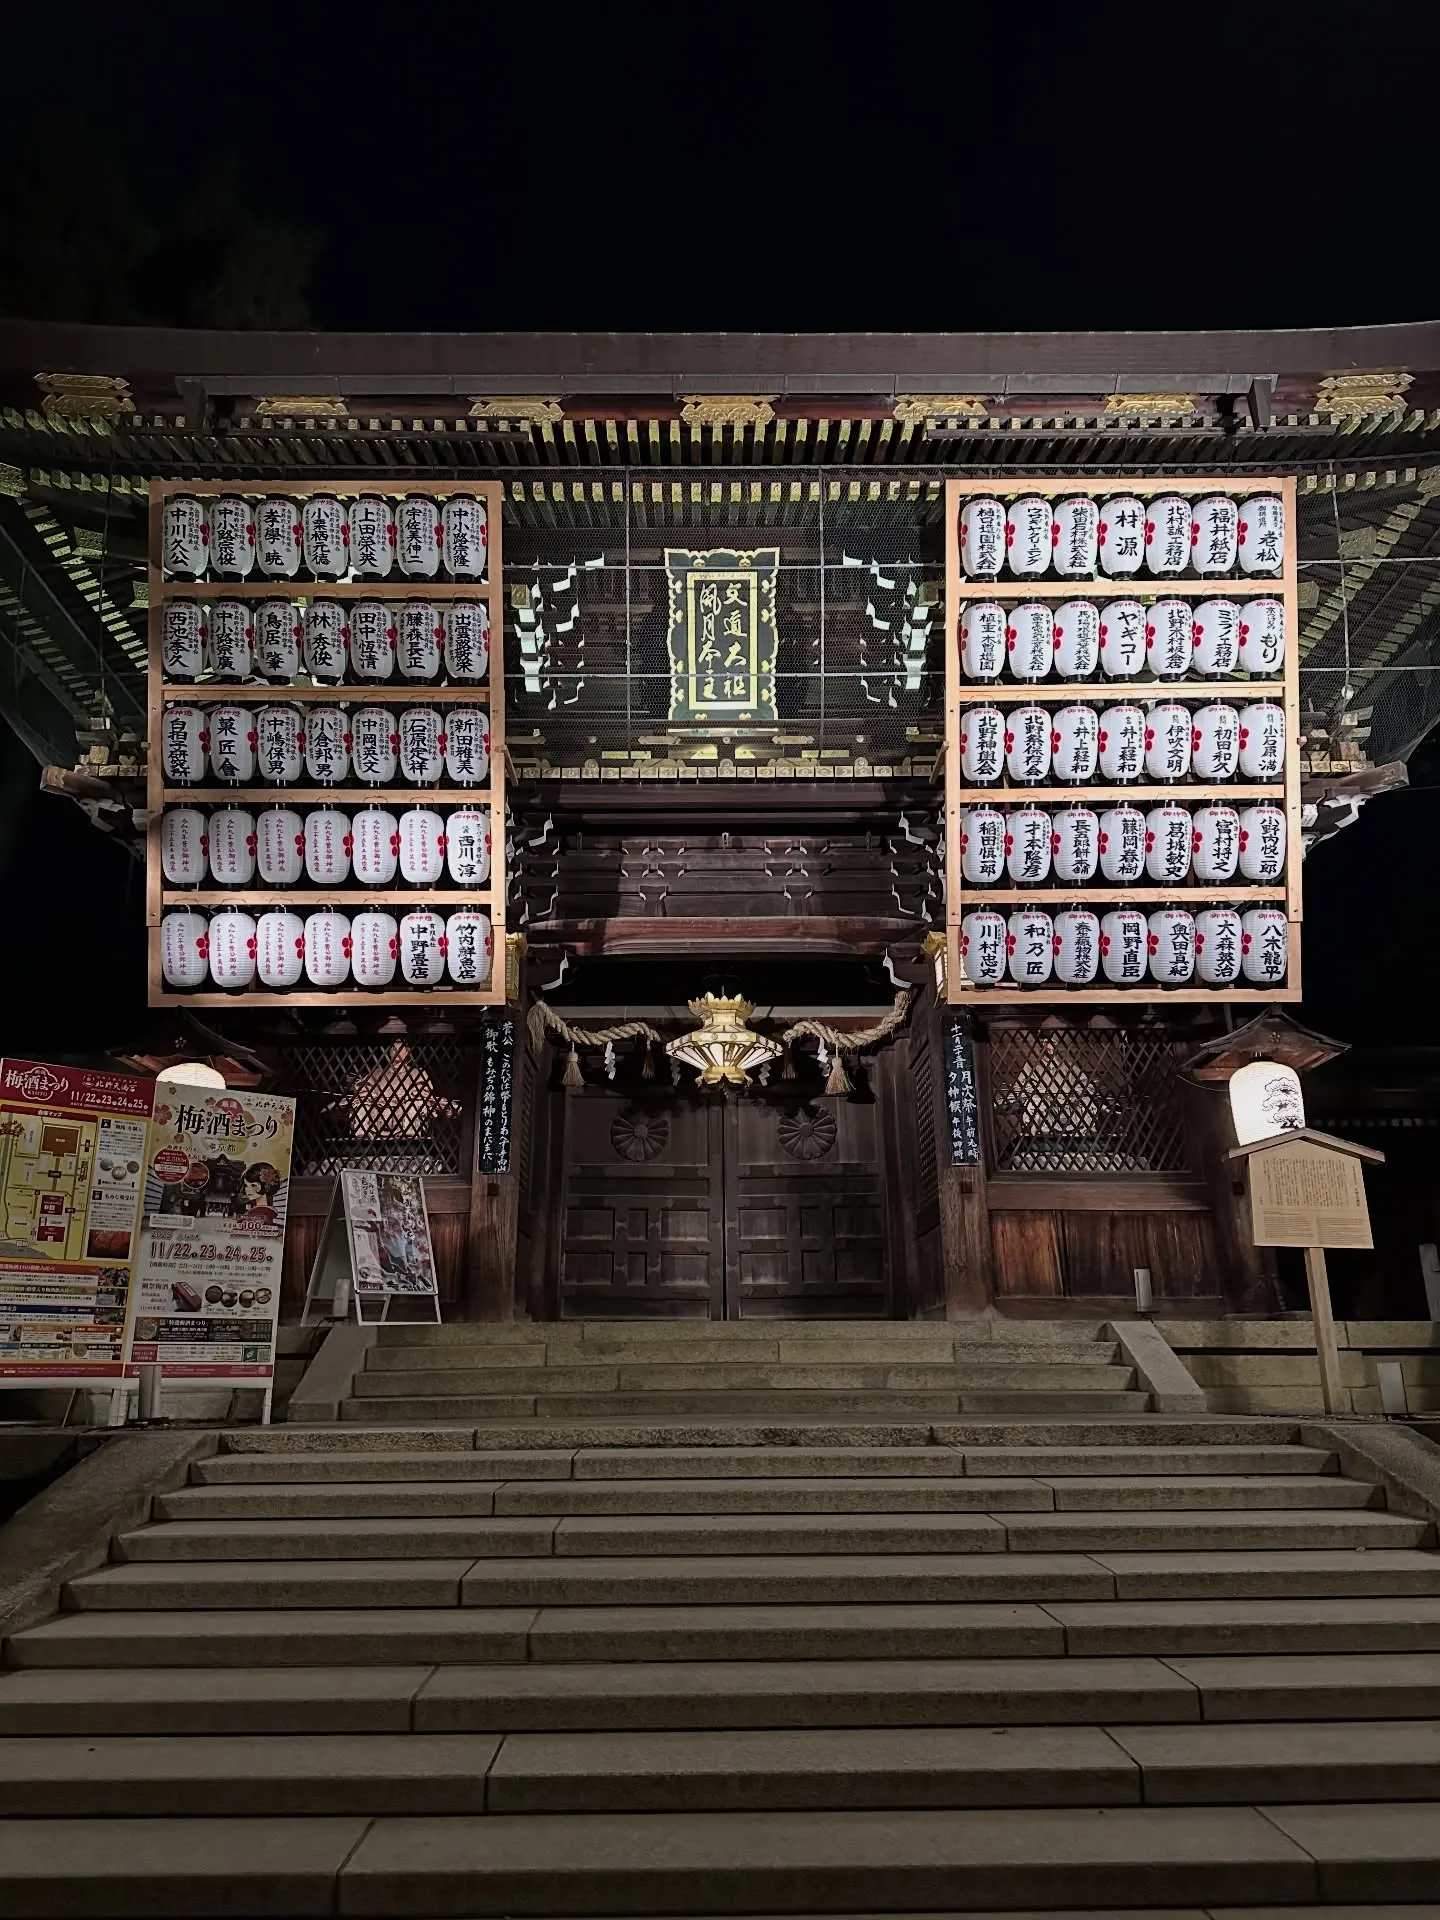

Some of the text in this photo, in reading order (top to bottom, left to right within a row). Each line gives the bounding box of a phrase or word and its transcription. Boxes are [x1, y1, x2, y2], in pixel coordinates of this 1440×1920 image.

[170, 508, 189, 566] 中川久公
[217, 508, 237, 565] 中小路宗俊
[311, 508, 331, 565] 小栗栖元徳
[405, 508, 423, 564] 宇佐美伸二
[452, 508, 470, 567] 中小路宗隆
[1163, 506, 1184, 566] 北村誠工務店
[1207, 508, 1230, 564] 福井紙店
[1255, 530, 1279, 562] 老松
[168, 612, 188, 667] 西池季久
[215, 611, 235, 670] 中小路宗廣
[406, 612, 425, 669] 藤森長正
[1117, 612, 1137, 665] ヤギコー
[1165, 609, 1185, 668] 北野木村板金店
[1211, 610, 1232, 667] ミラノ工務店
[1260, 633, 1277, 663] もり
[168, 718, 191, 777] 白拍子研究所
[314, 718, 334, 776] 小倉邦男
[362, 718, 380, 774] 中岡英文
[408, 719, 429, 776] 石原定祥
[455, 719, 475, 775] 新田雅美
[973, 717, 997, 776] 北野神輿会
[1023, 716, 1044, 776] 北野祭保存会
[1166, 725, 1185, 772] 伊吹文明
[1211, 728, 1232, 773] 初田和久
[1258, 726, 1278, 772] 小石原満
[458, 836, 477, 877] 西川淳
[978, 821, 997, 877] 稲田慎一郎
[1117, 818, 1139, 876] 藤岡春樹
[1163, 822, 1185, 877] 葛城敏史
[456, 923, 477, 979] 竹内鮮魚店
[978, 924, 998, 978] 川村忠史
[1024, 924, 1046, 975] 和乃匠
[1121, 922, 1142, 977] 岡野直臣
[1168, 922, 1190, 976] 奥田真紀
[1215, 920, 1235, 978] 大森英治
[1260, 925, 1282, 979] 八木龍平
[502, 1021, 513, 1045] 菅公
[5, 1069, 69, 1092] 梅酒まつり
[961, 1071, 976, 1113] 月次祭
[175, 1104, 278, 1140] 梅酒まつり
